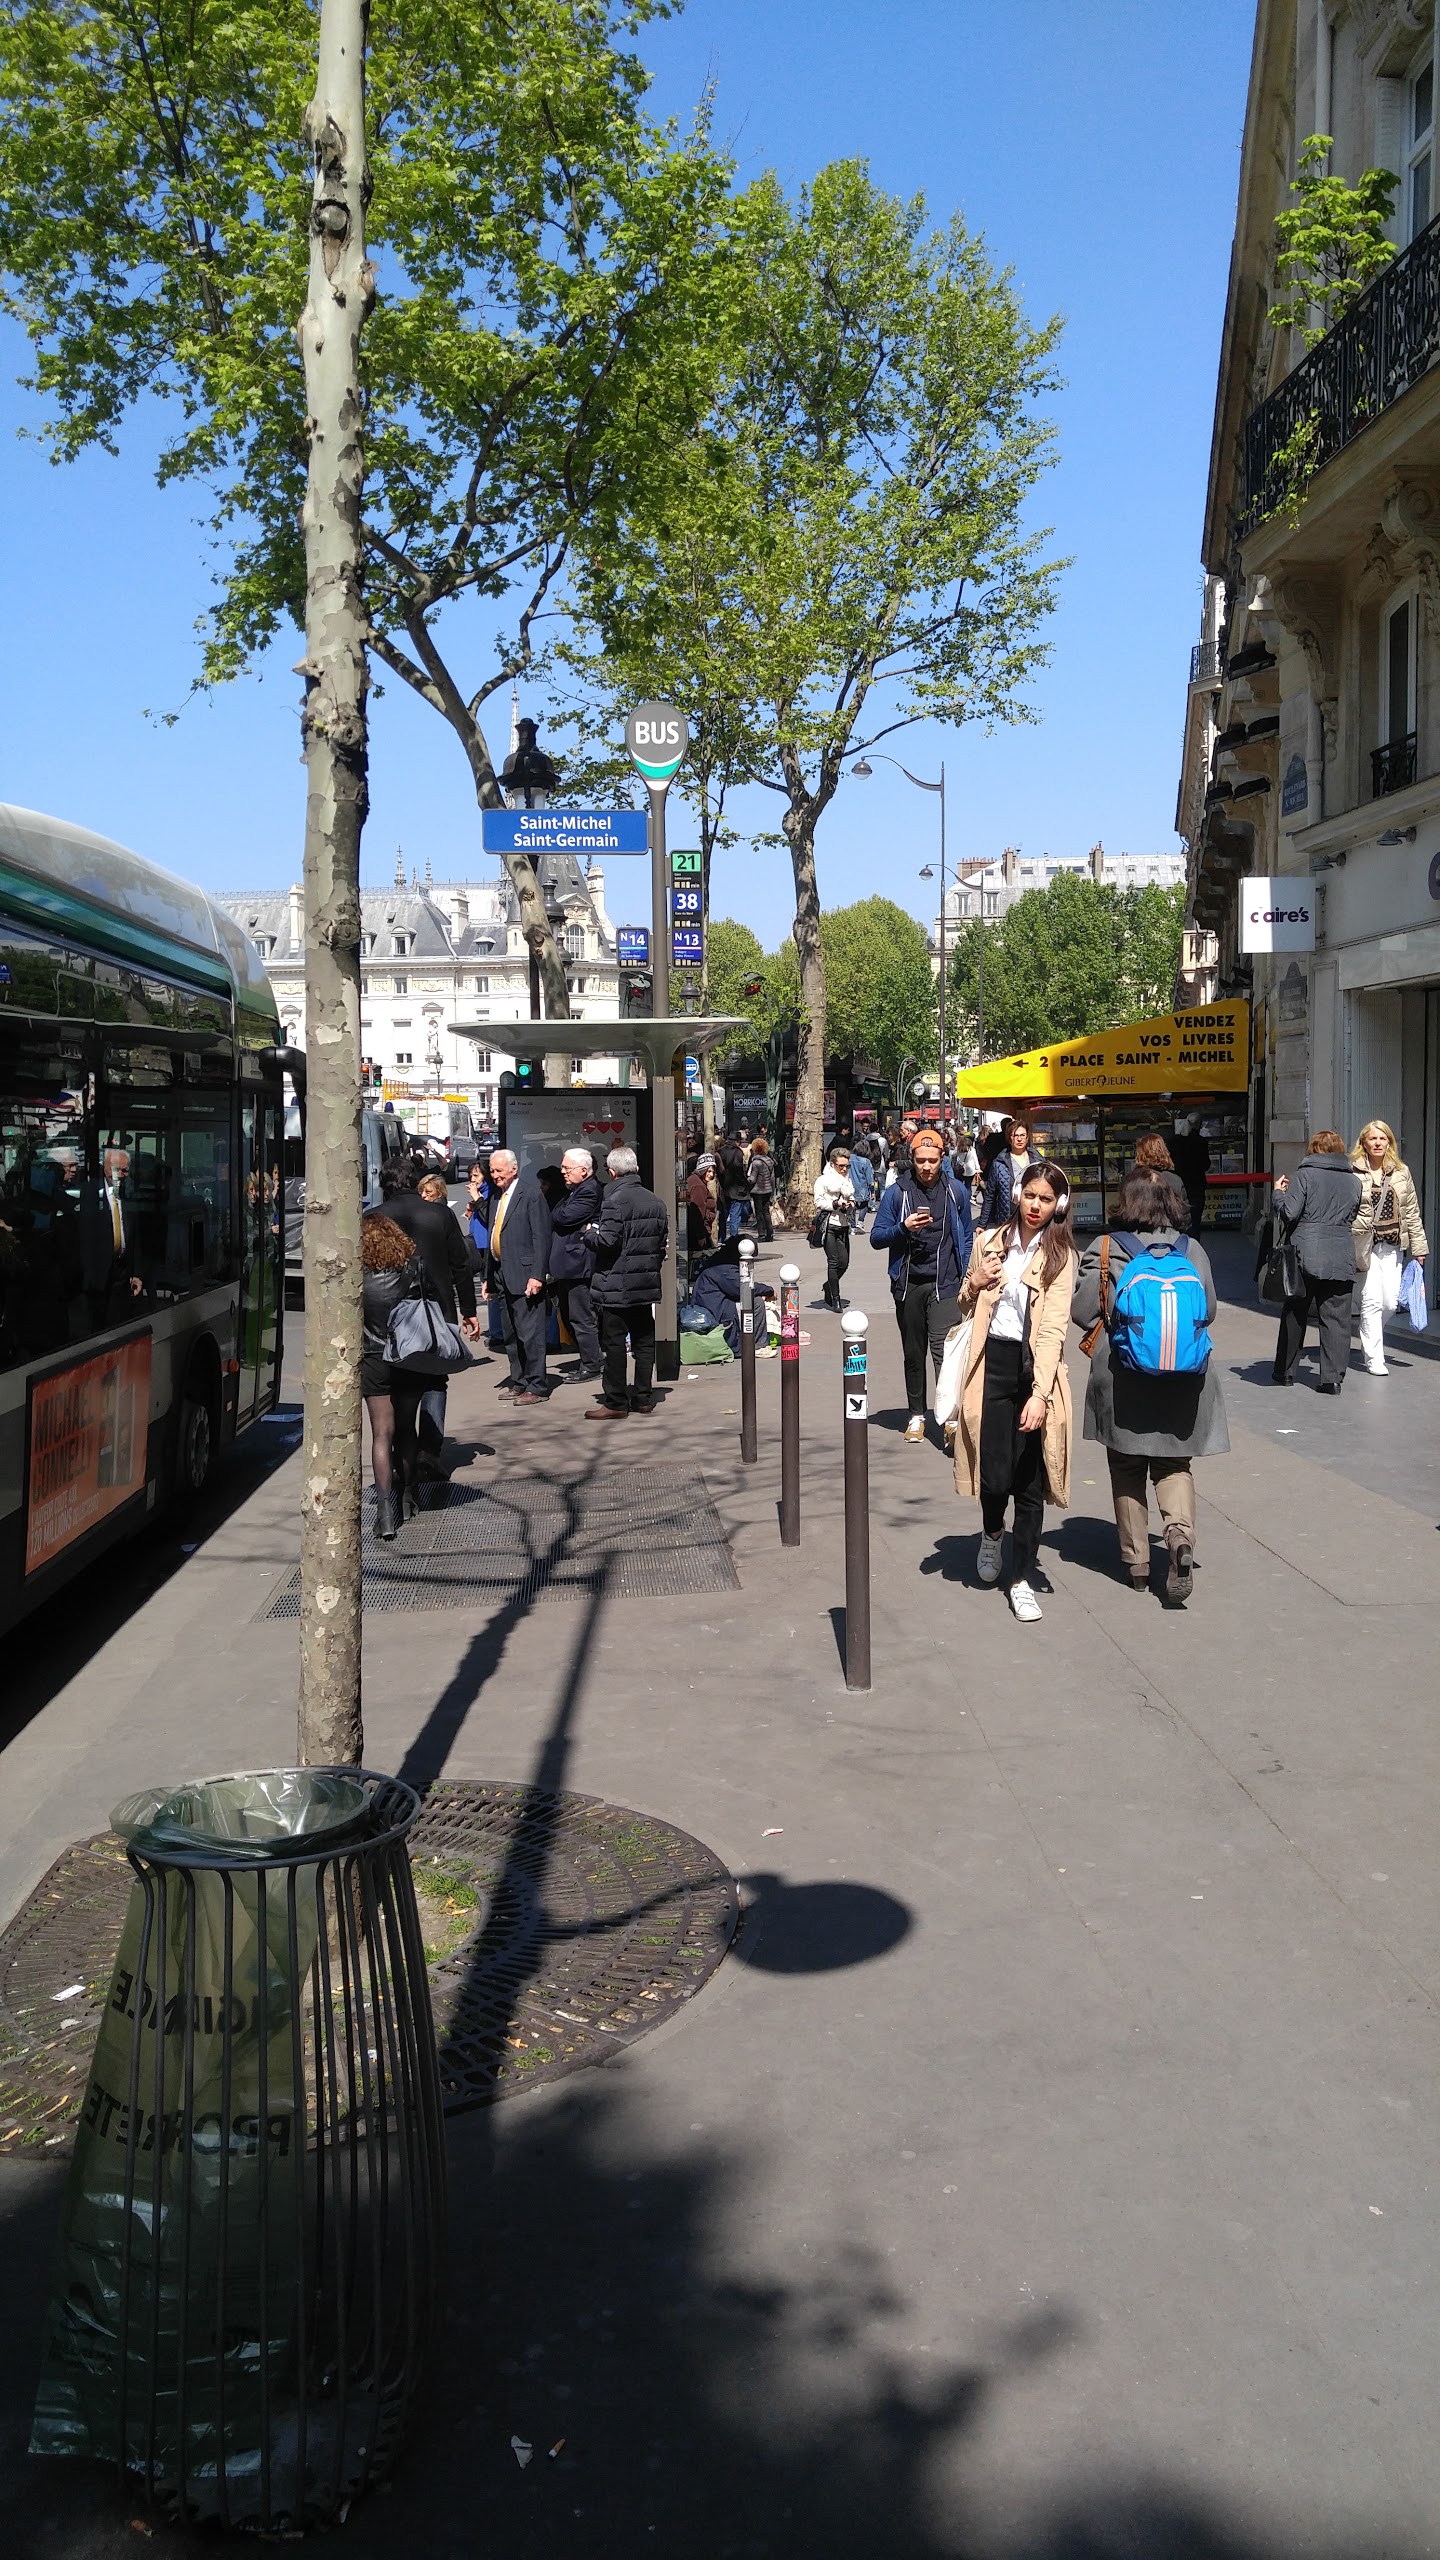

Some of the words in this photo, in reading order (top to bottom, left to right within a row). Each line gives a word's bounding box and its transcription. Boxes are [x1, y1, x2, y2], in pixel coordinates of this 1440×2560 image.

[634, 720, 680, 745] BUS
[519, 815, 612, 830] Saint-Michel
[513, 833, 619, 847] Saint-Germain
[676, 854, 697, 871] 21
[676, 893, 699, 910] 38
[1250, 906, 1310, 924] caire's
[1174, 1014, 1235, 1028] VENDEZ
[1139, 1034, 1171, 1047] VOS
[1183, 1032, 1235, 1046] LIVRES
[1039, 1056, 1049, 1068] 2
[1060, 1054, 1104, 1067] PLACE
[1115, 1052, 1161, 1065] SAINT
[1178, 1050, 1235, 1063] MICHEL
[1064, 1076, 1097, 1087] GIBERT
[1105, 1075, 1136, 1086] JEUNE
